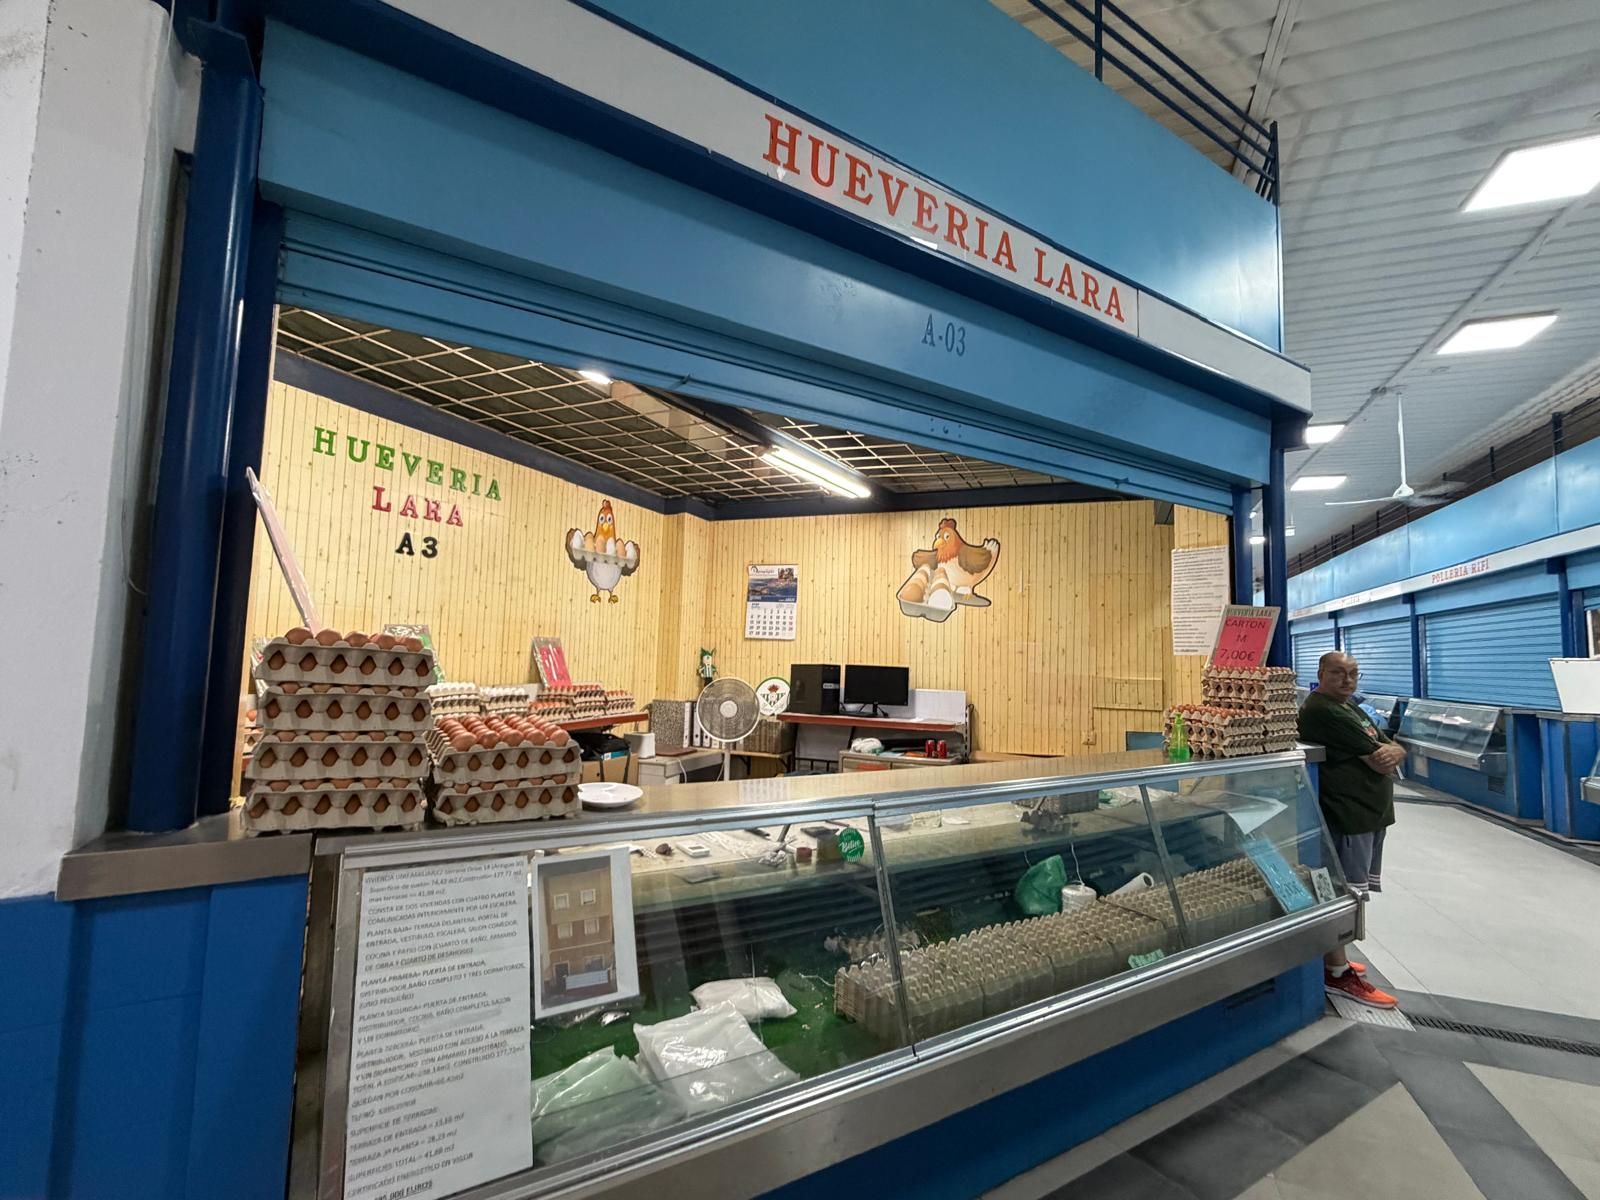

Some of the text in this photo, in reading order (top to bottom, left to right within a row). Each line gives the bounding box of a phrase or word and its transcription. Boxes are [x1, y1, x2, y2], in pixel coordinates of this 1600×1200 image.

[763, 114, 1125, 323] HUEVERIA LARA
[921, 313, 967, 357] A-03
[313, 426, 501, 501] HUEVERIA
[372, 486, 464, 527] LARA
[1431, 565, 1469, 584] POLLERIA
[1225, 618, 1266, 629] CARTON
[1236, 633, 1247, 643] M
[1219, 648, 1256, 662] 7,00€
[466, 894, 489, 902] CUATRO
[490, 890, 515, 899] PLANTAS
[366, 928, 391, 937] PLANTA
[414, 921, 440, 930] TERRAZA
[478, 912, 499, 921] PORTAL
[367, 913, 415, 925] COMUNICADAS
[375, 960, 393, 969] OBRA
[400, 955, 426, 965] CUARTO
[361, 976, 386, 987] PLANTA
[422, 966, 446, 976] PUERTA
[428, 973, 461, 985] COMPLETO
[468, 970, 481, 978] TRES
[359, 1010, 384, 1021] PLANTA
[423, 998, 447, 1009] PUERTA
[436, 1007, 453, 1017] BAÑO
[356, 1046, 382, 1058] PLANTA
[418, 1032, 443, 1044] PUERTA
[353, 1081, 374, 1093] TOTAL
[394, 1154, 416, 1168] TOTAL
